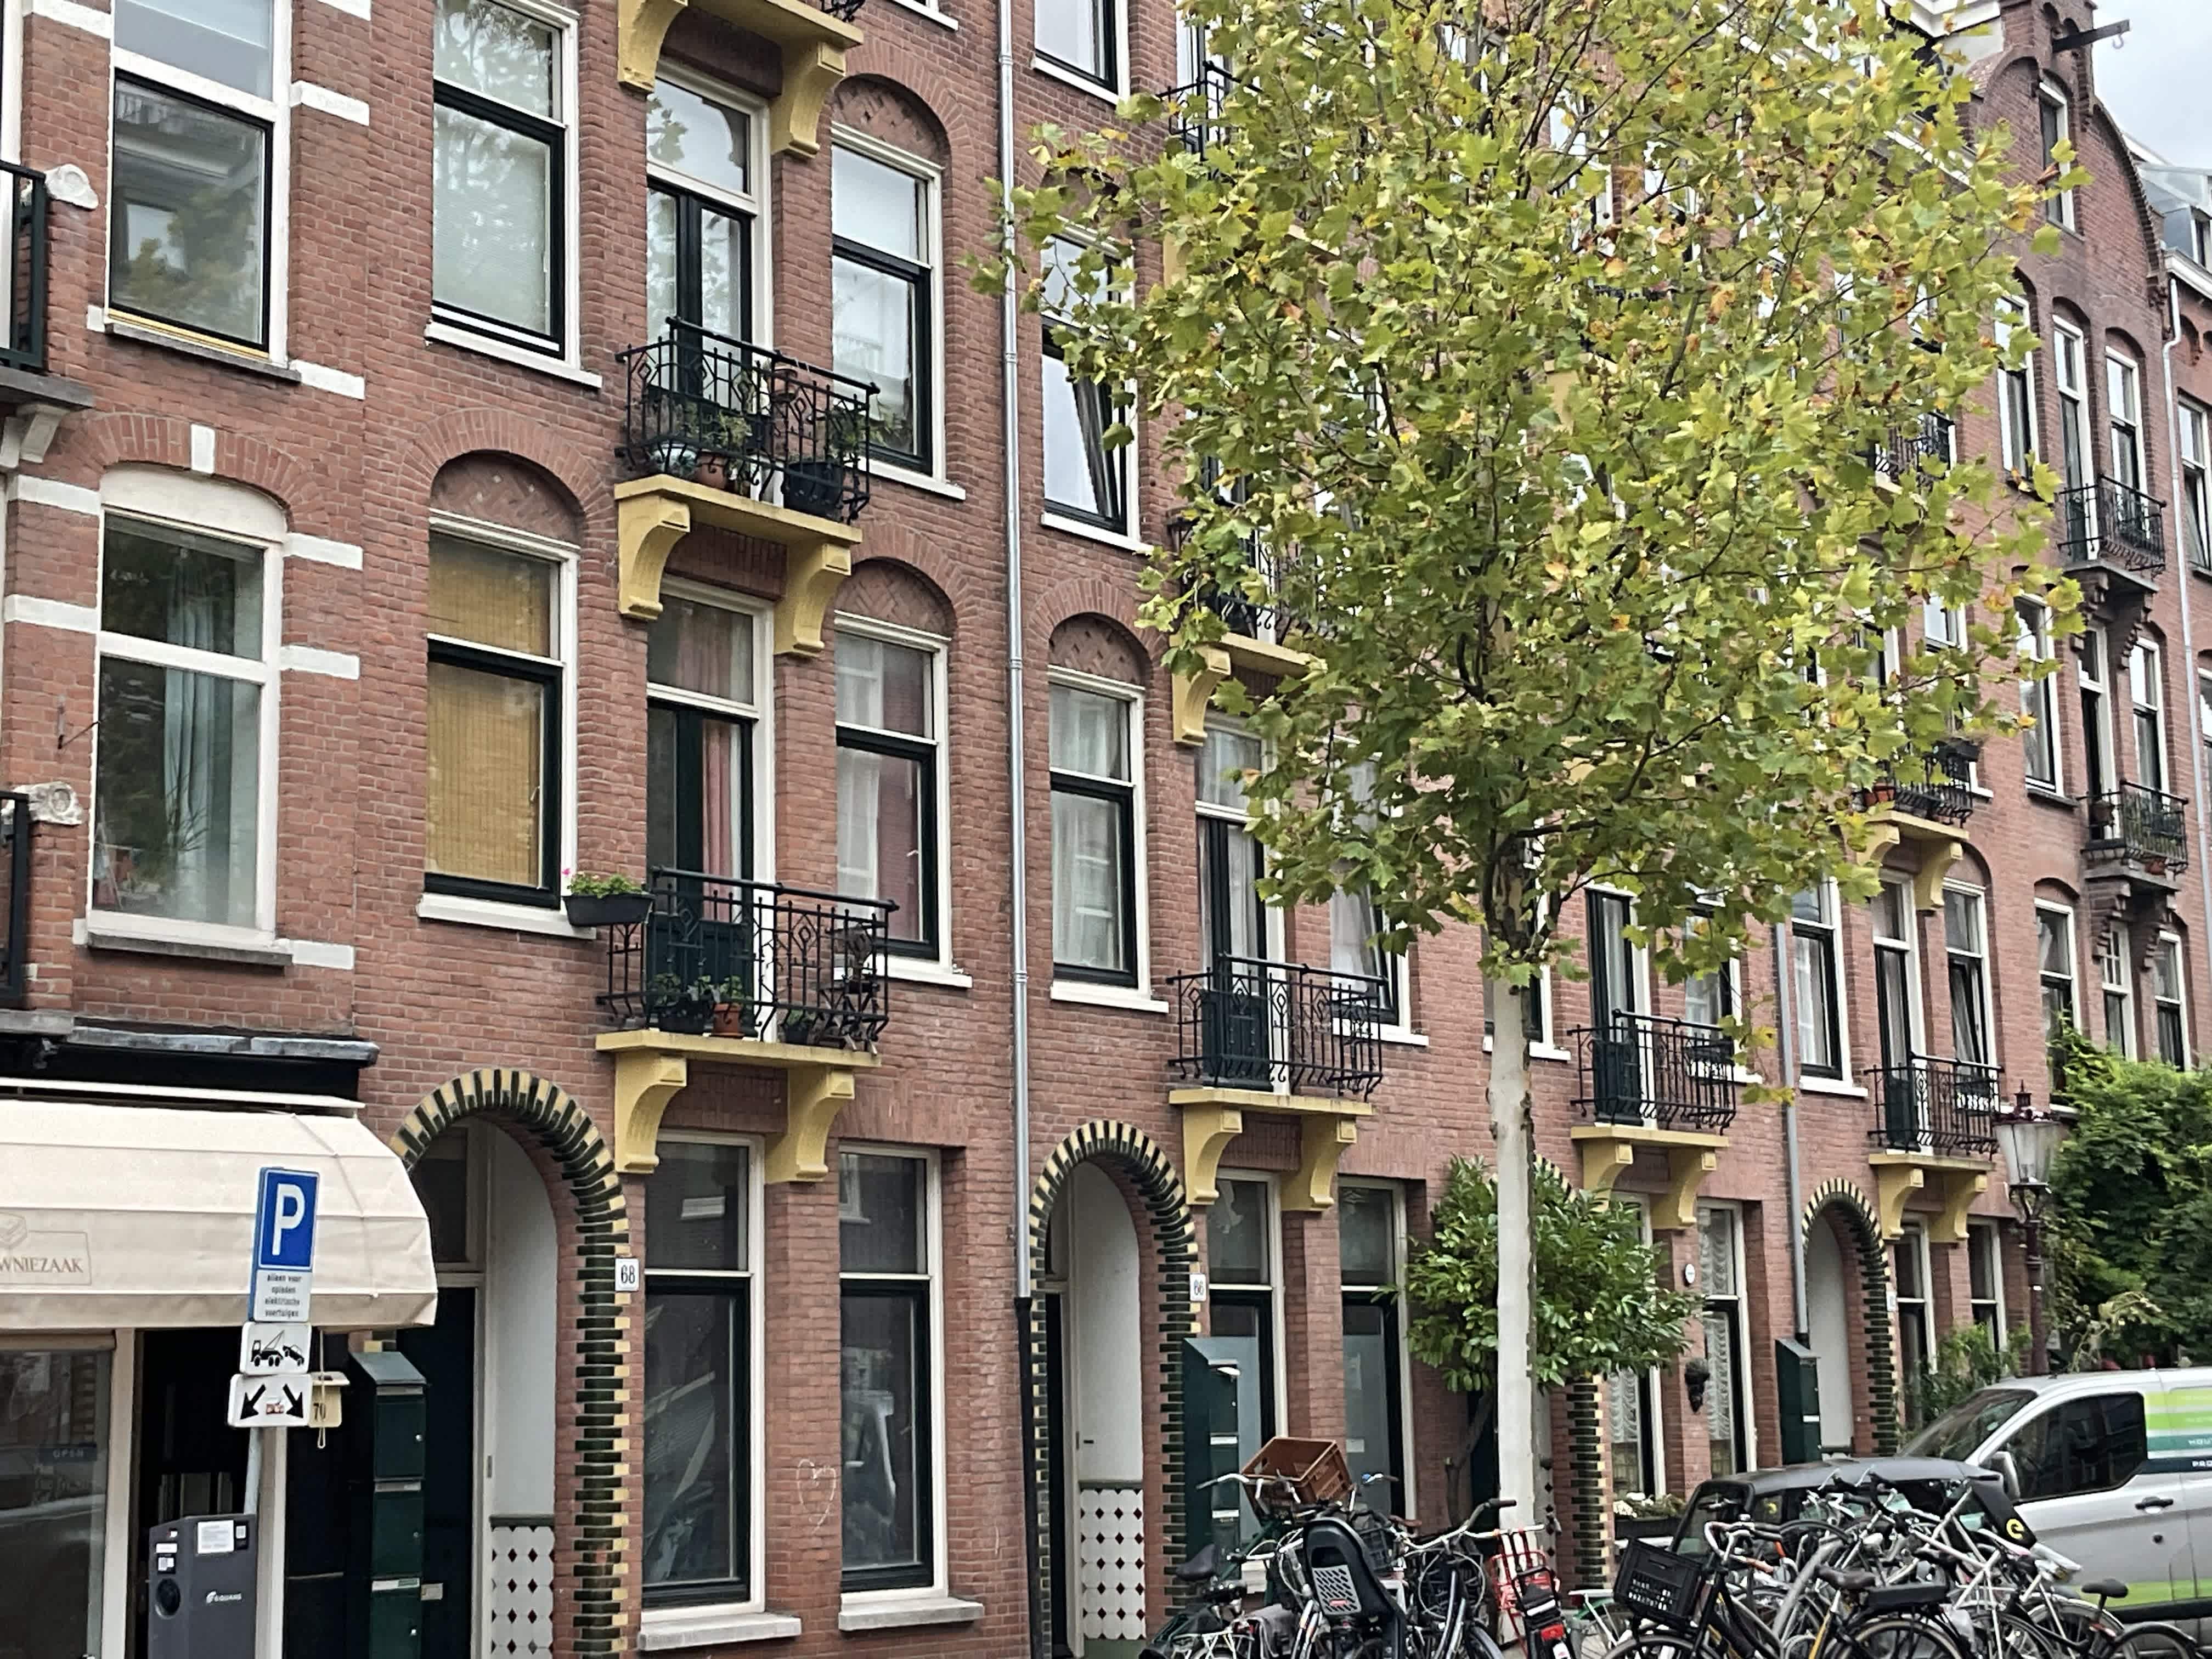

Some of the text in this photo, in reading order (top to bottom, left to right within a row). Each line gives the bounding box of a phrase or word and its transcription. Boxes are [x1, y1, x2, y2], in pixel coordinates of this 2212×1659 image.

[272, 1183, 306, 1256] P
[621, 1265, 635, 1284] 68
[314, 1403, 326, 1421] 70
